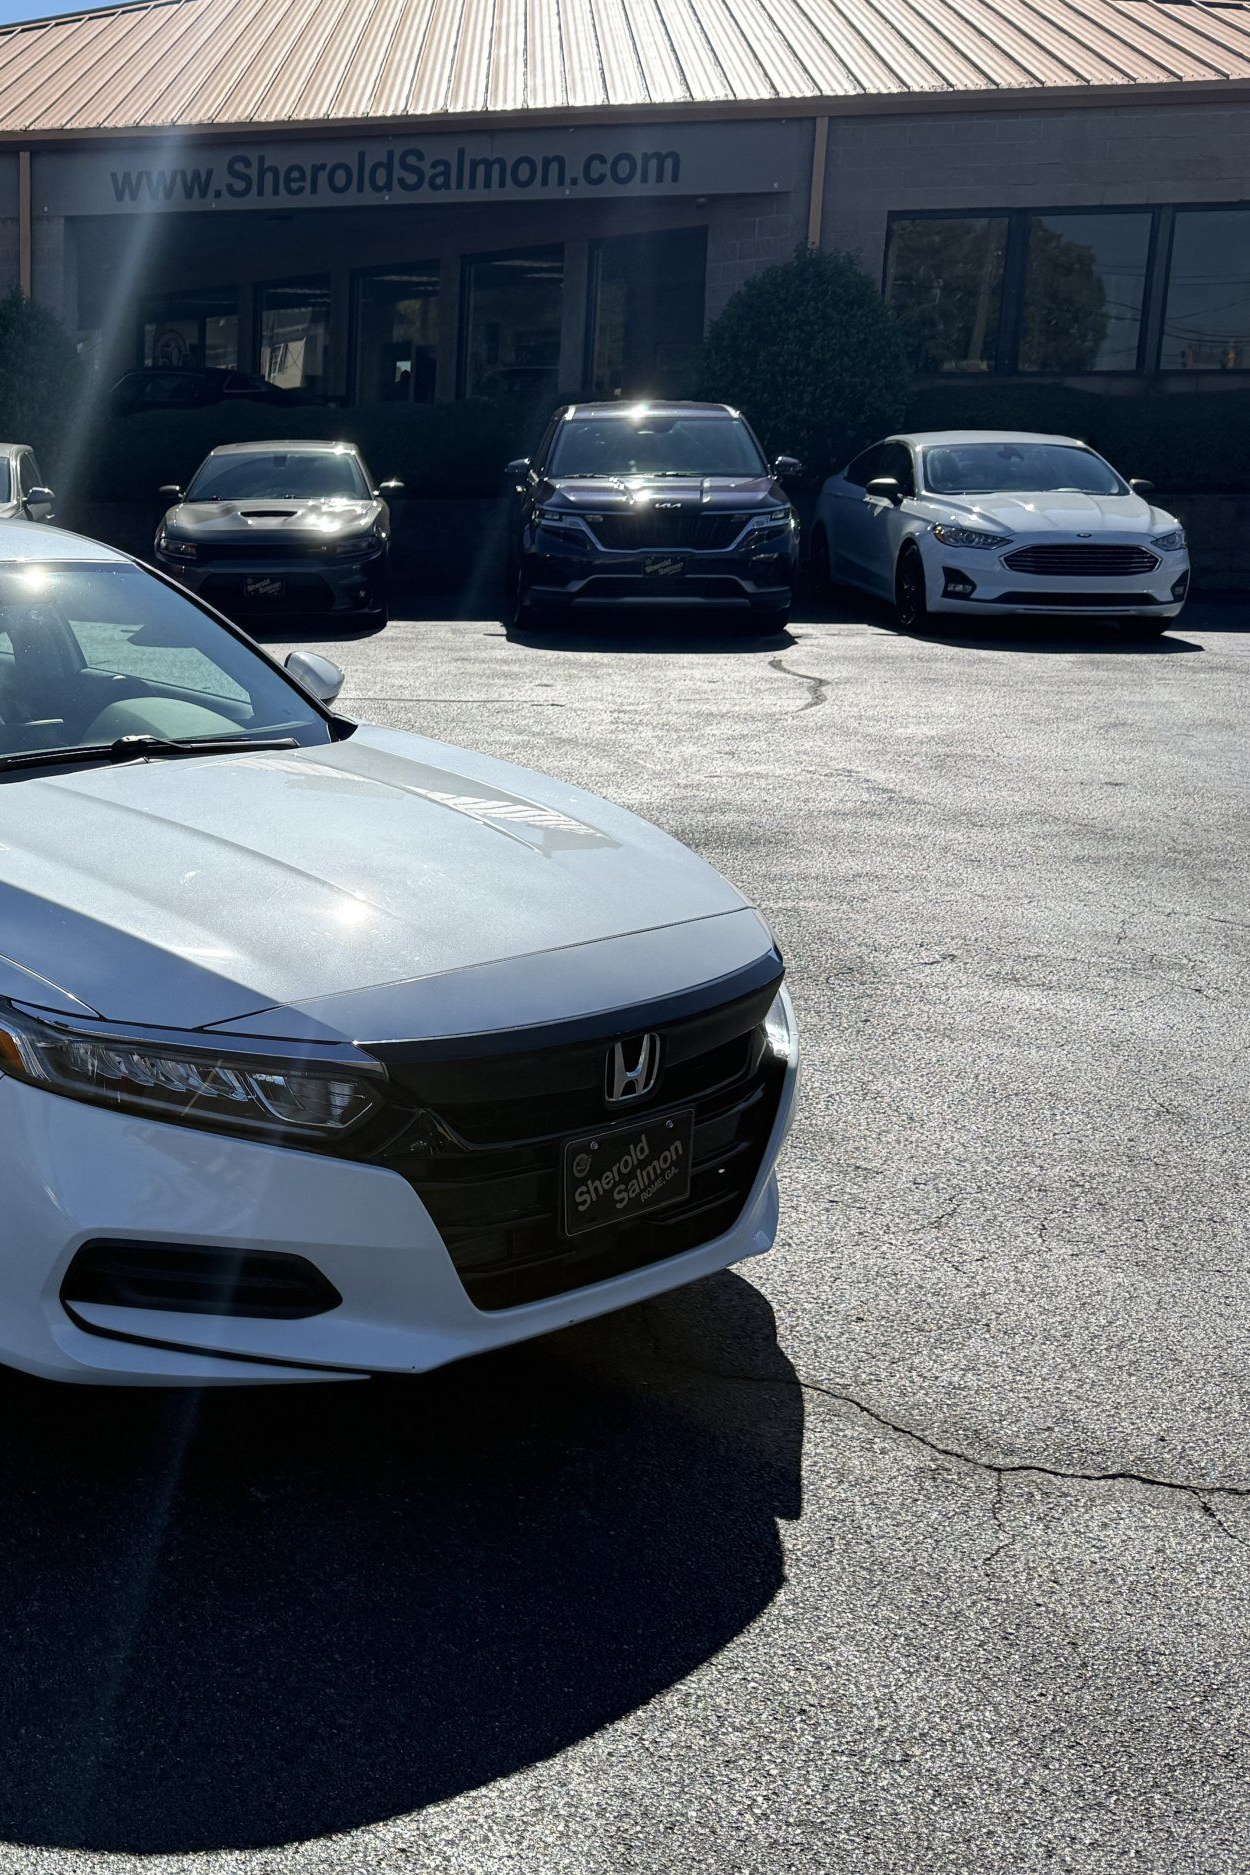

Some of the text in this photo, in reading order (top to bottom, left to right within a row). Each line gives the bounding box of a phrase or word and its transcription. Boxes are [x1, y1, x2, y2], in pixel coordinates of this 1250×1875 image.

[111, 146, 681, 202] www.SheroldSalmon.com
[574, 1134, 650, 1212] Sherold
[613, 1140, 683, 1209] Salmon
